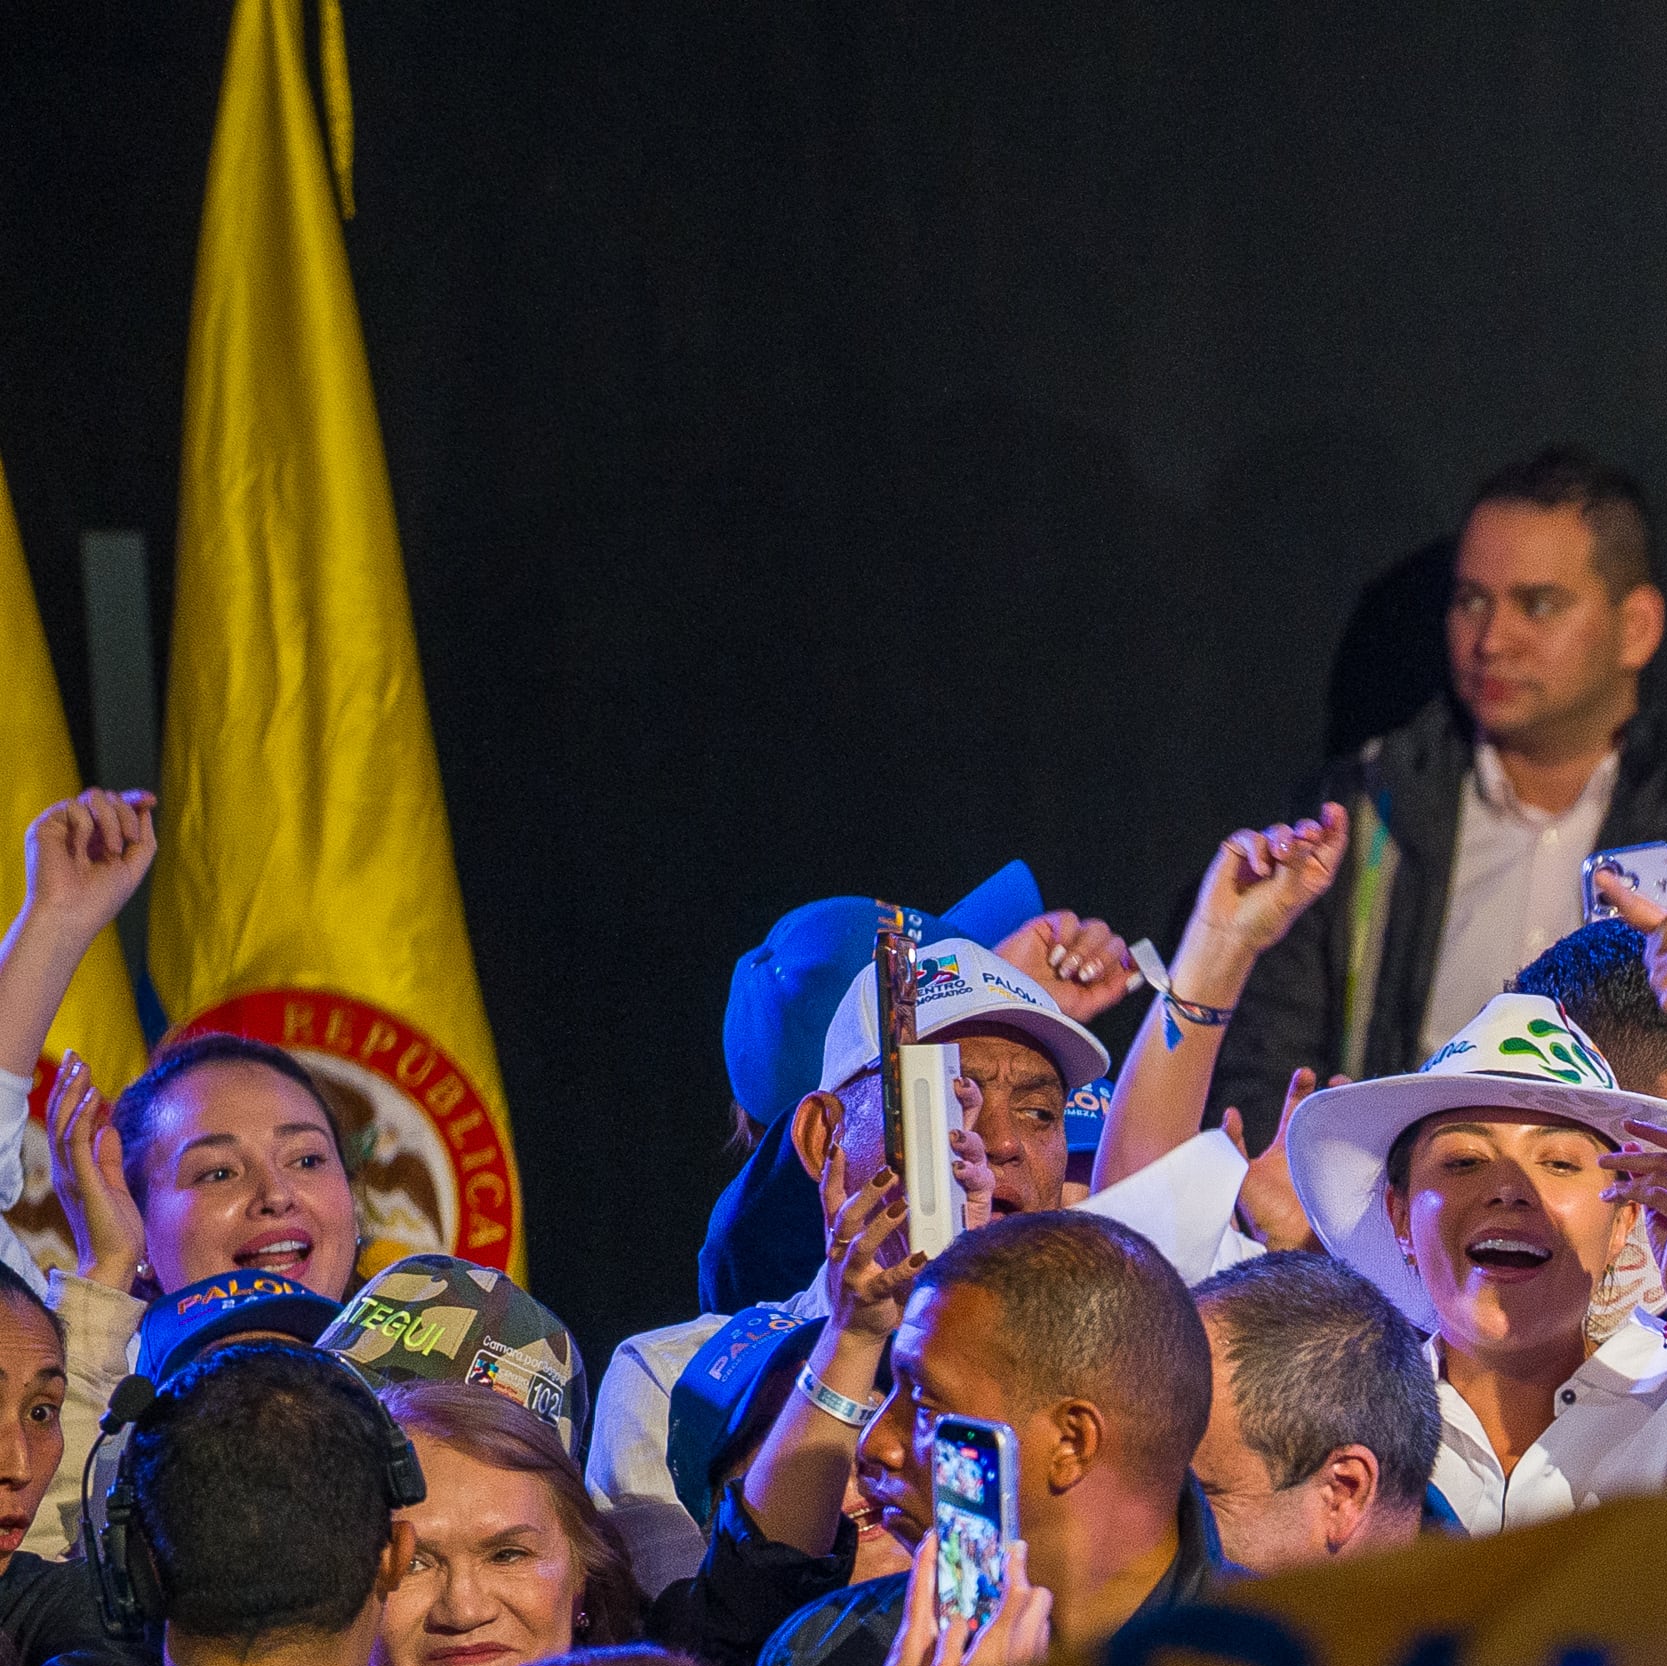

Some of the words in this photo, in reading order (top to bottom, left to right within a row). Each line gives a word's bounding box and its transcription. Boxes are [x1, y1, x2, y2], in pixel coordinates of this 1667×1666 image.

[918, 979, 966, 997] ENTRO
[347, 1295, 448, 1357] TEGUI
[531, 1382, 561, 1424] 102
